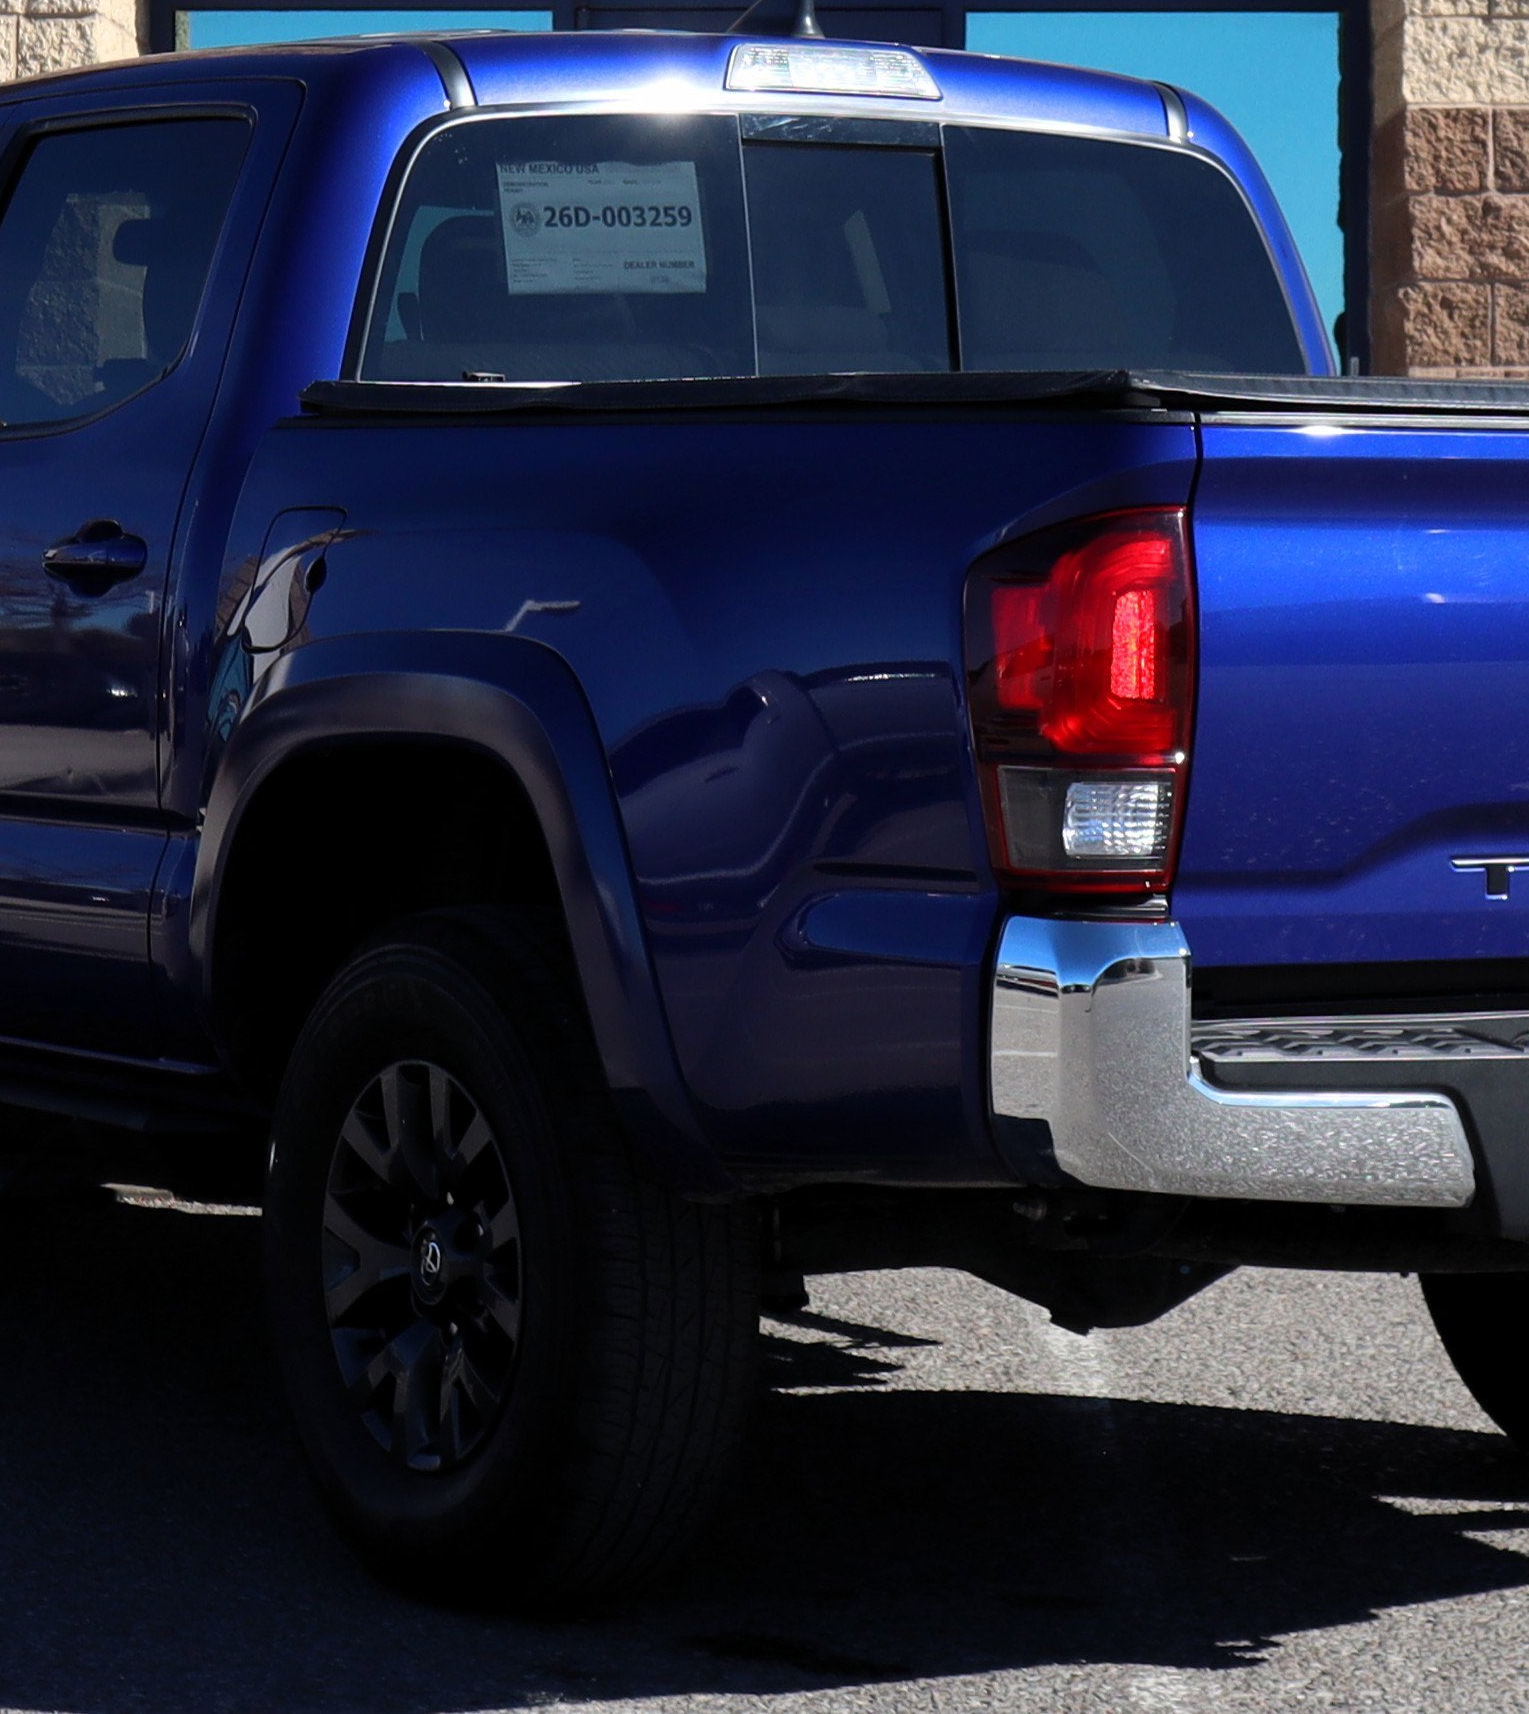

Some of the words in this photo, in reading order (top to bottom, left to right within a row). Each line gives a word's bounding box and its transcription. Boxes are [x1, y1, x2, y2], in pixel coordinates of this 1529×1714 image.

[500, 164, 526, 174] NEW
[529, 163, 573, 174] MEXICO
[576, 165, 600, 174] USA
[543, 205, 693, 228] 26D-003259
[624, 260, 657, 270] DEALER
[659, 260, 695, 269] NUMBER
